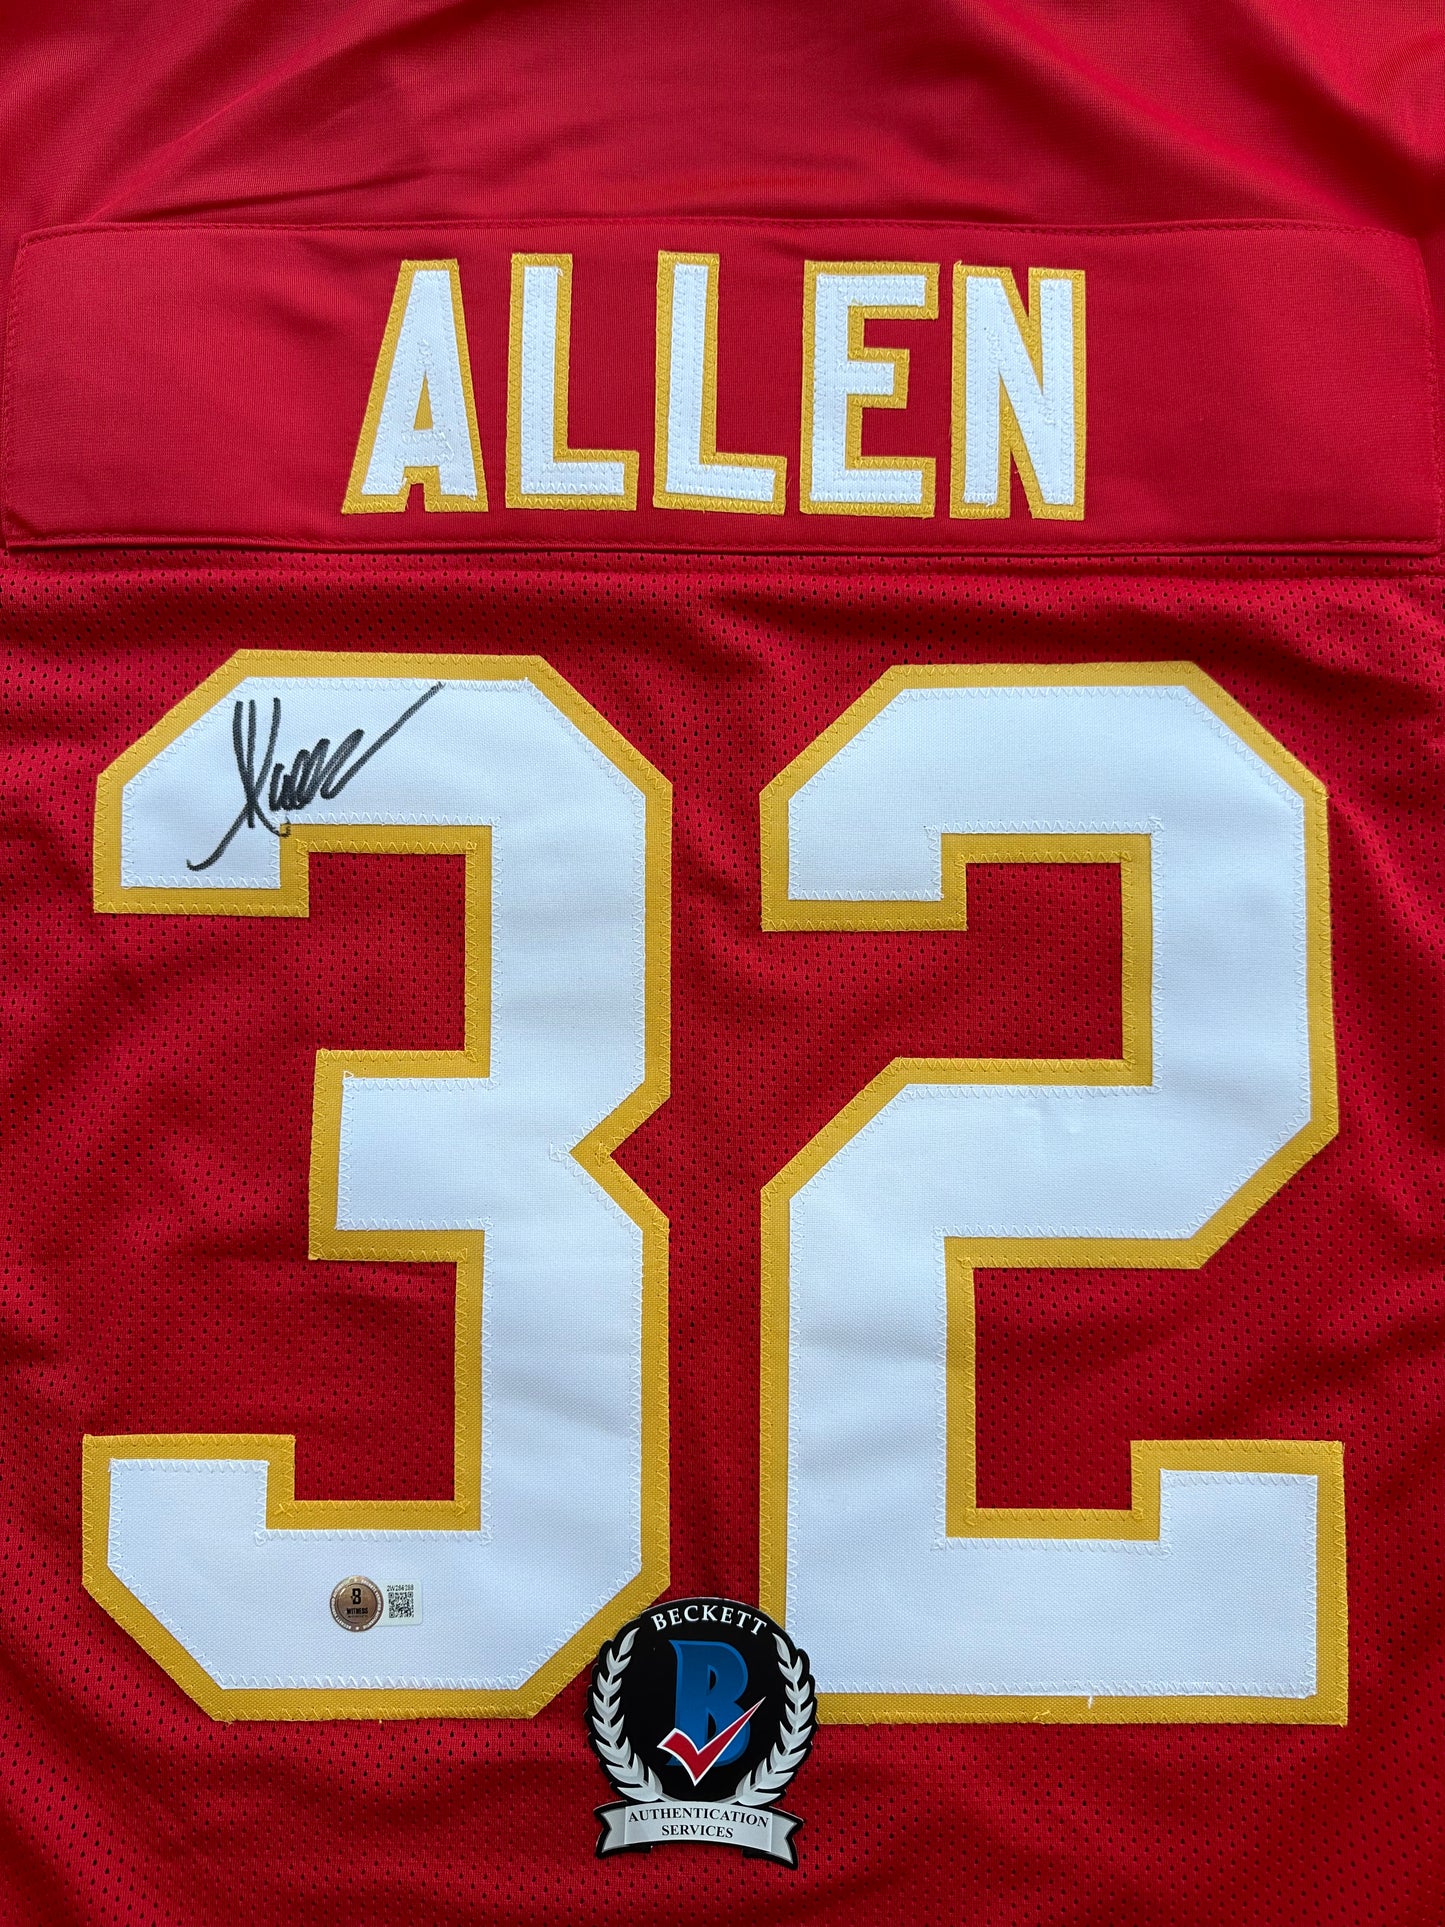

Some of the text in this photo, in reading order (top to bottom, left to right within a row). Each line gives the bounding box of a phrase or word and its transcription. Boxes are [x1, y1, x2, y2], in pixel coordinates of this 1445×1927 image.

[341, 249, 1086, 521] ALLEN
[82, 648, 1349, 1727] 32
[346, 1607, 369, 1615] WITNESS
[650, 1604, 767, 1636] BECKETT
[628, 1807, 769, 1828] AUTHENTICATION
[661, 1824, 734, 1839] SERVICES
